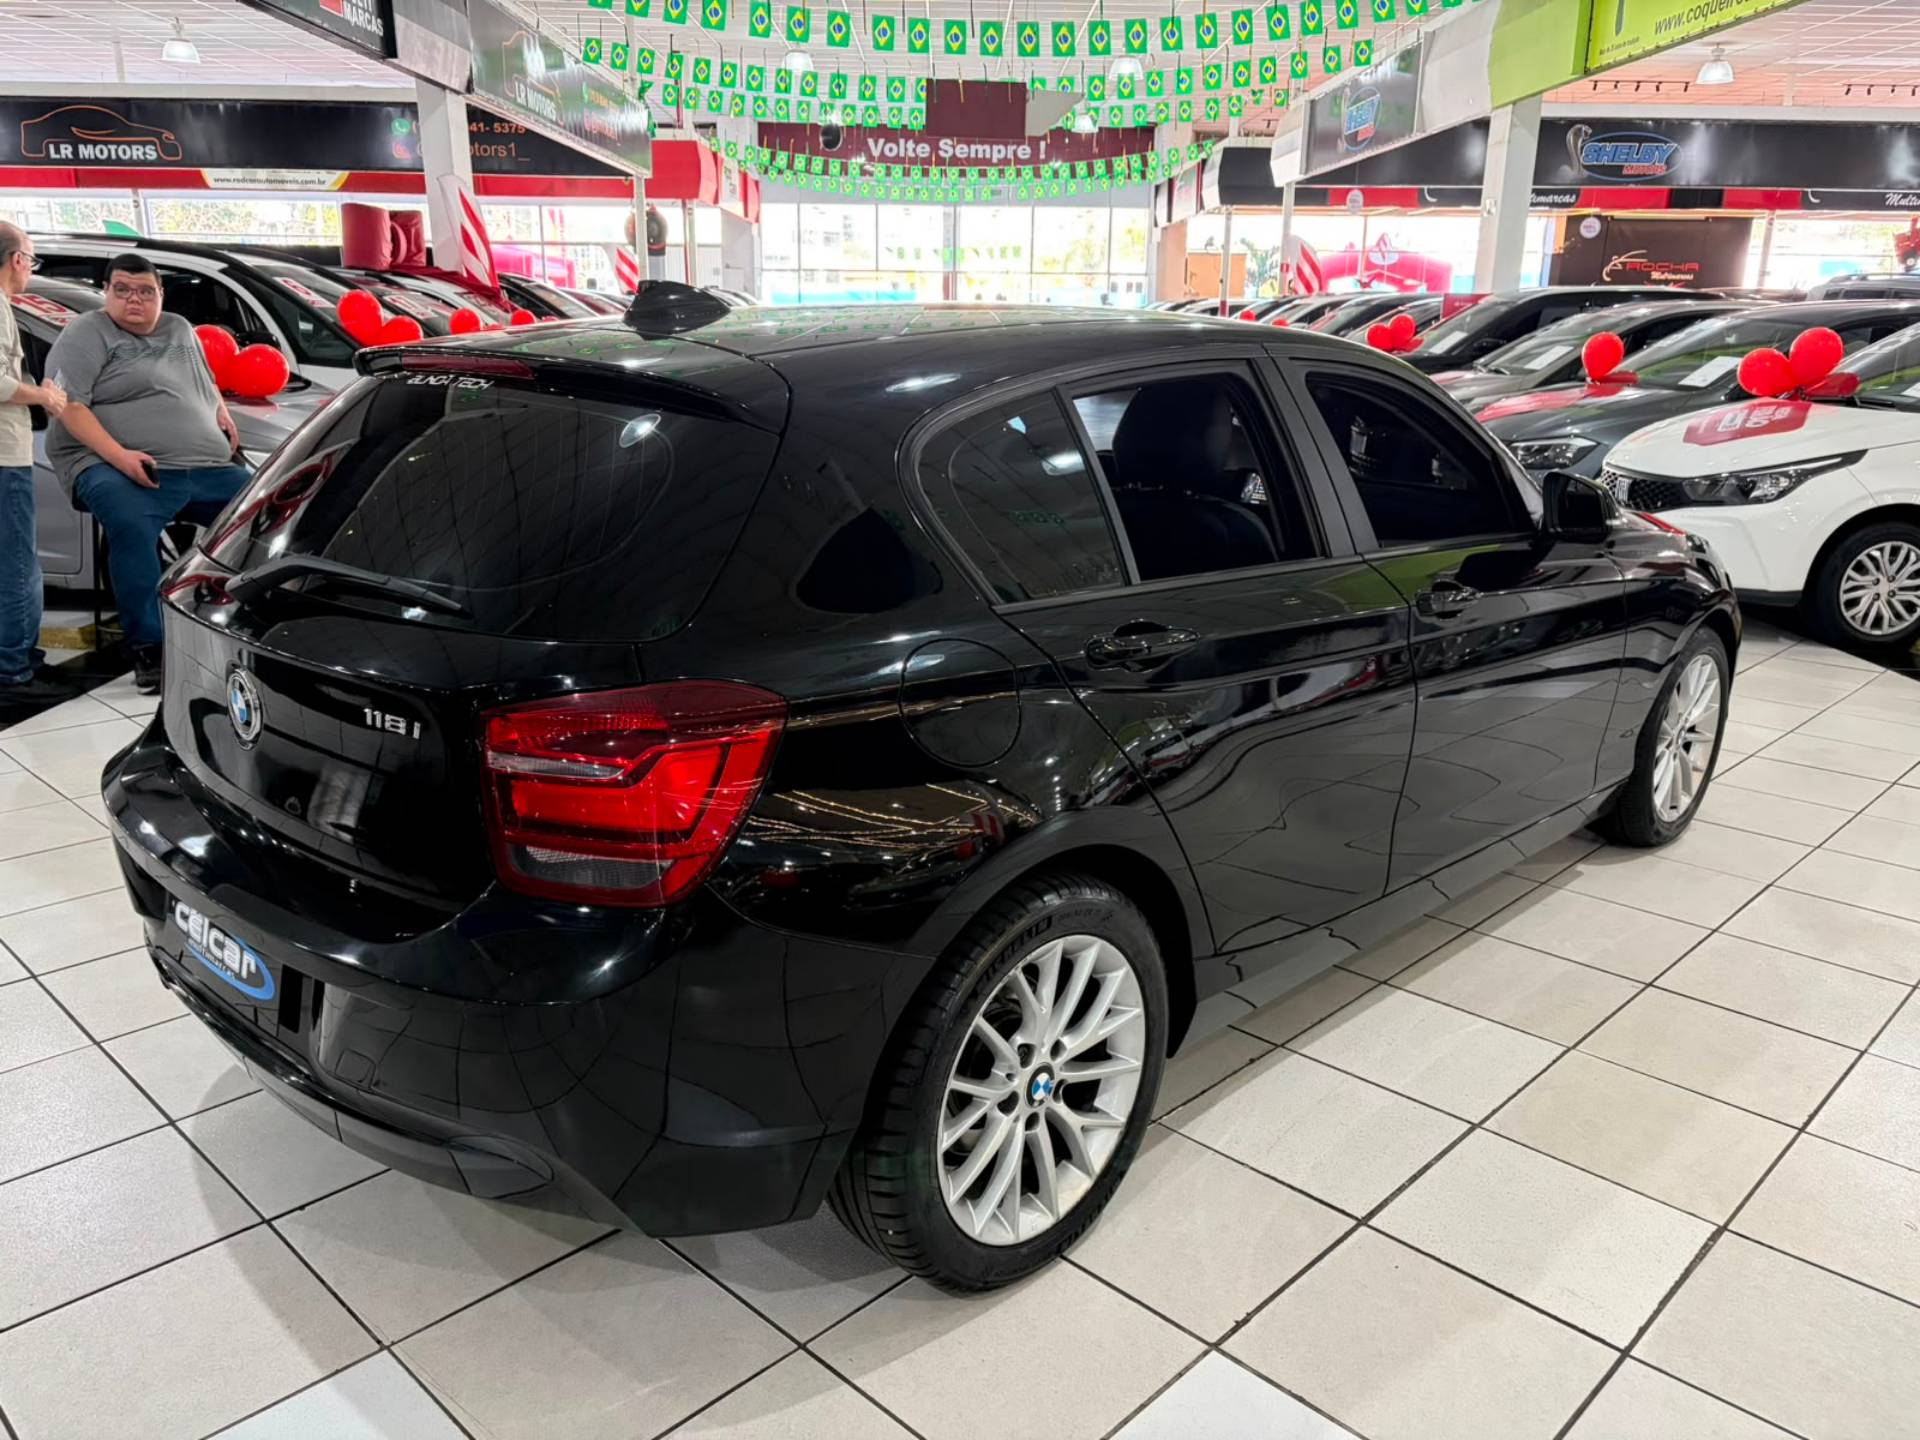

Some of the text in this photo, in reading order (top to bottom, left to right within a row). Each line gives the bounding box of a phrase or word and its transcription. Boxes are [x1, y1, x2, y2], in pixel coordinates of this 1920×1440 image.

[343, 1, 384, 36] MARCAS
[1654, 0, 1750, 35] www.coqueir
[494, 122, 526, 133] 5375
[49, 143, 158, 160] LR MOTORS
[867, 138, 931, 157] Volte
[938, 139, 1032, 162] Sempre
[1581, 142, 1678, 165] SHELBY
[1885, 192, 1920, 206] Multi
[1626, 262, 1699, 271] ROCHA
